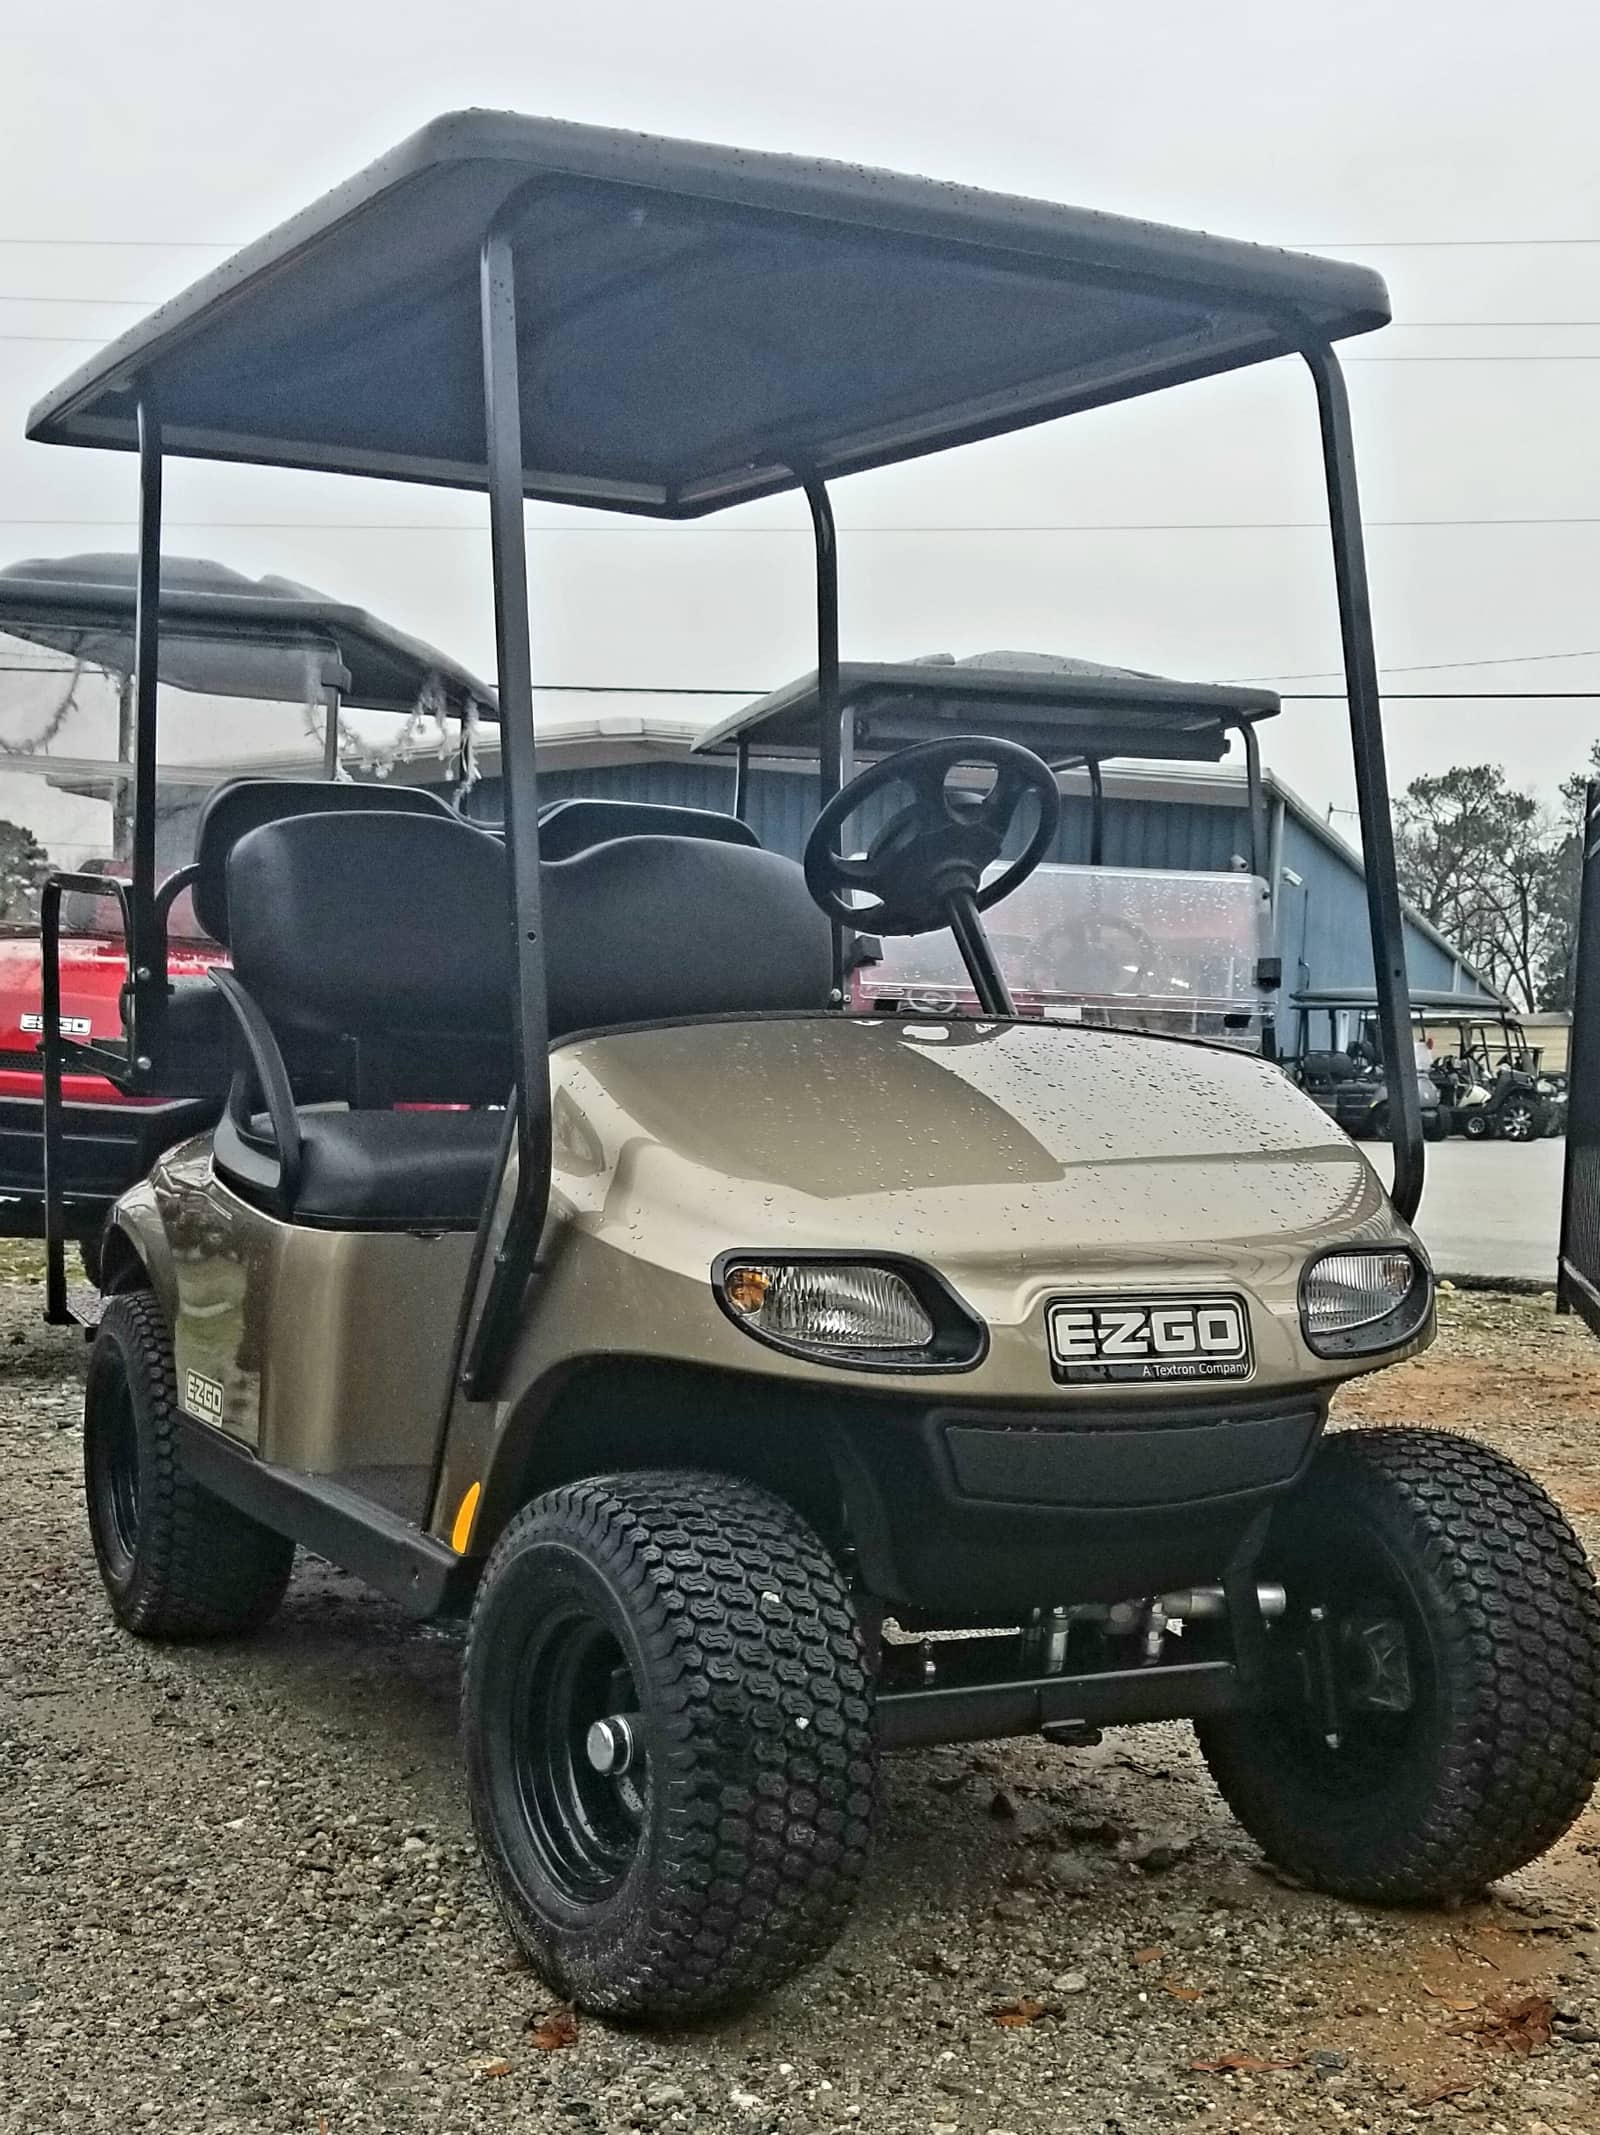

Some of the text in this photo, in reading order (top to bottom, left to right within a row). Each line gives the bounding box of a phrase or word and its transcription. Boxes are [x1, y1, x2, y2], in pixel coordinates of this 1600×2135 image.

[1143, 1362, 1248, 1377] A Textron Company
